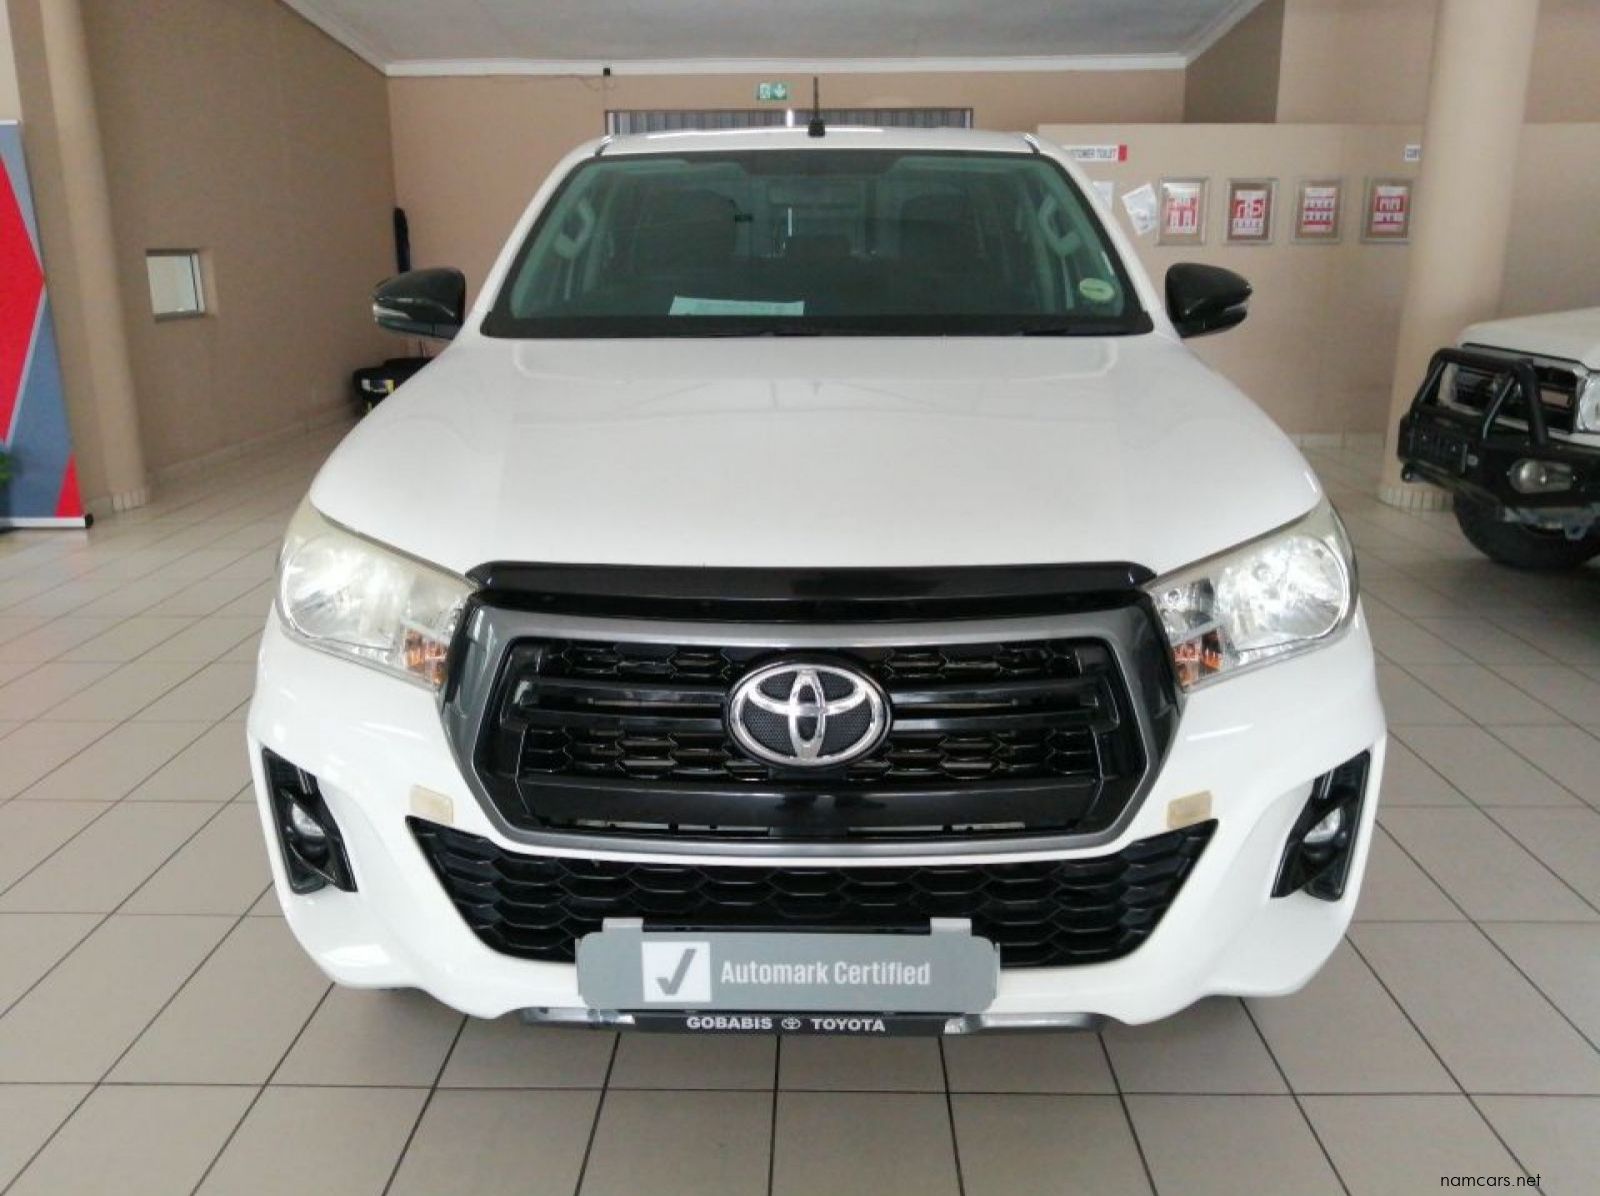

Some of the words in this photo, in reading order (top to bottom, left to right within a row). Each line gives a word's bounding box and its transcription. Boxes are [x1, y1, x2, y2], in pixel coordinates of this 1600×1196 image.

[721, 960, 830, 985] Automark
[834, 961, 931, 985] Certified
[686, 1016, 773, 1030] GOBABIS
[811, 1018, 886, 1032] TOYOTA
